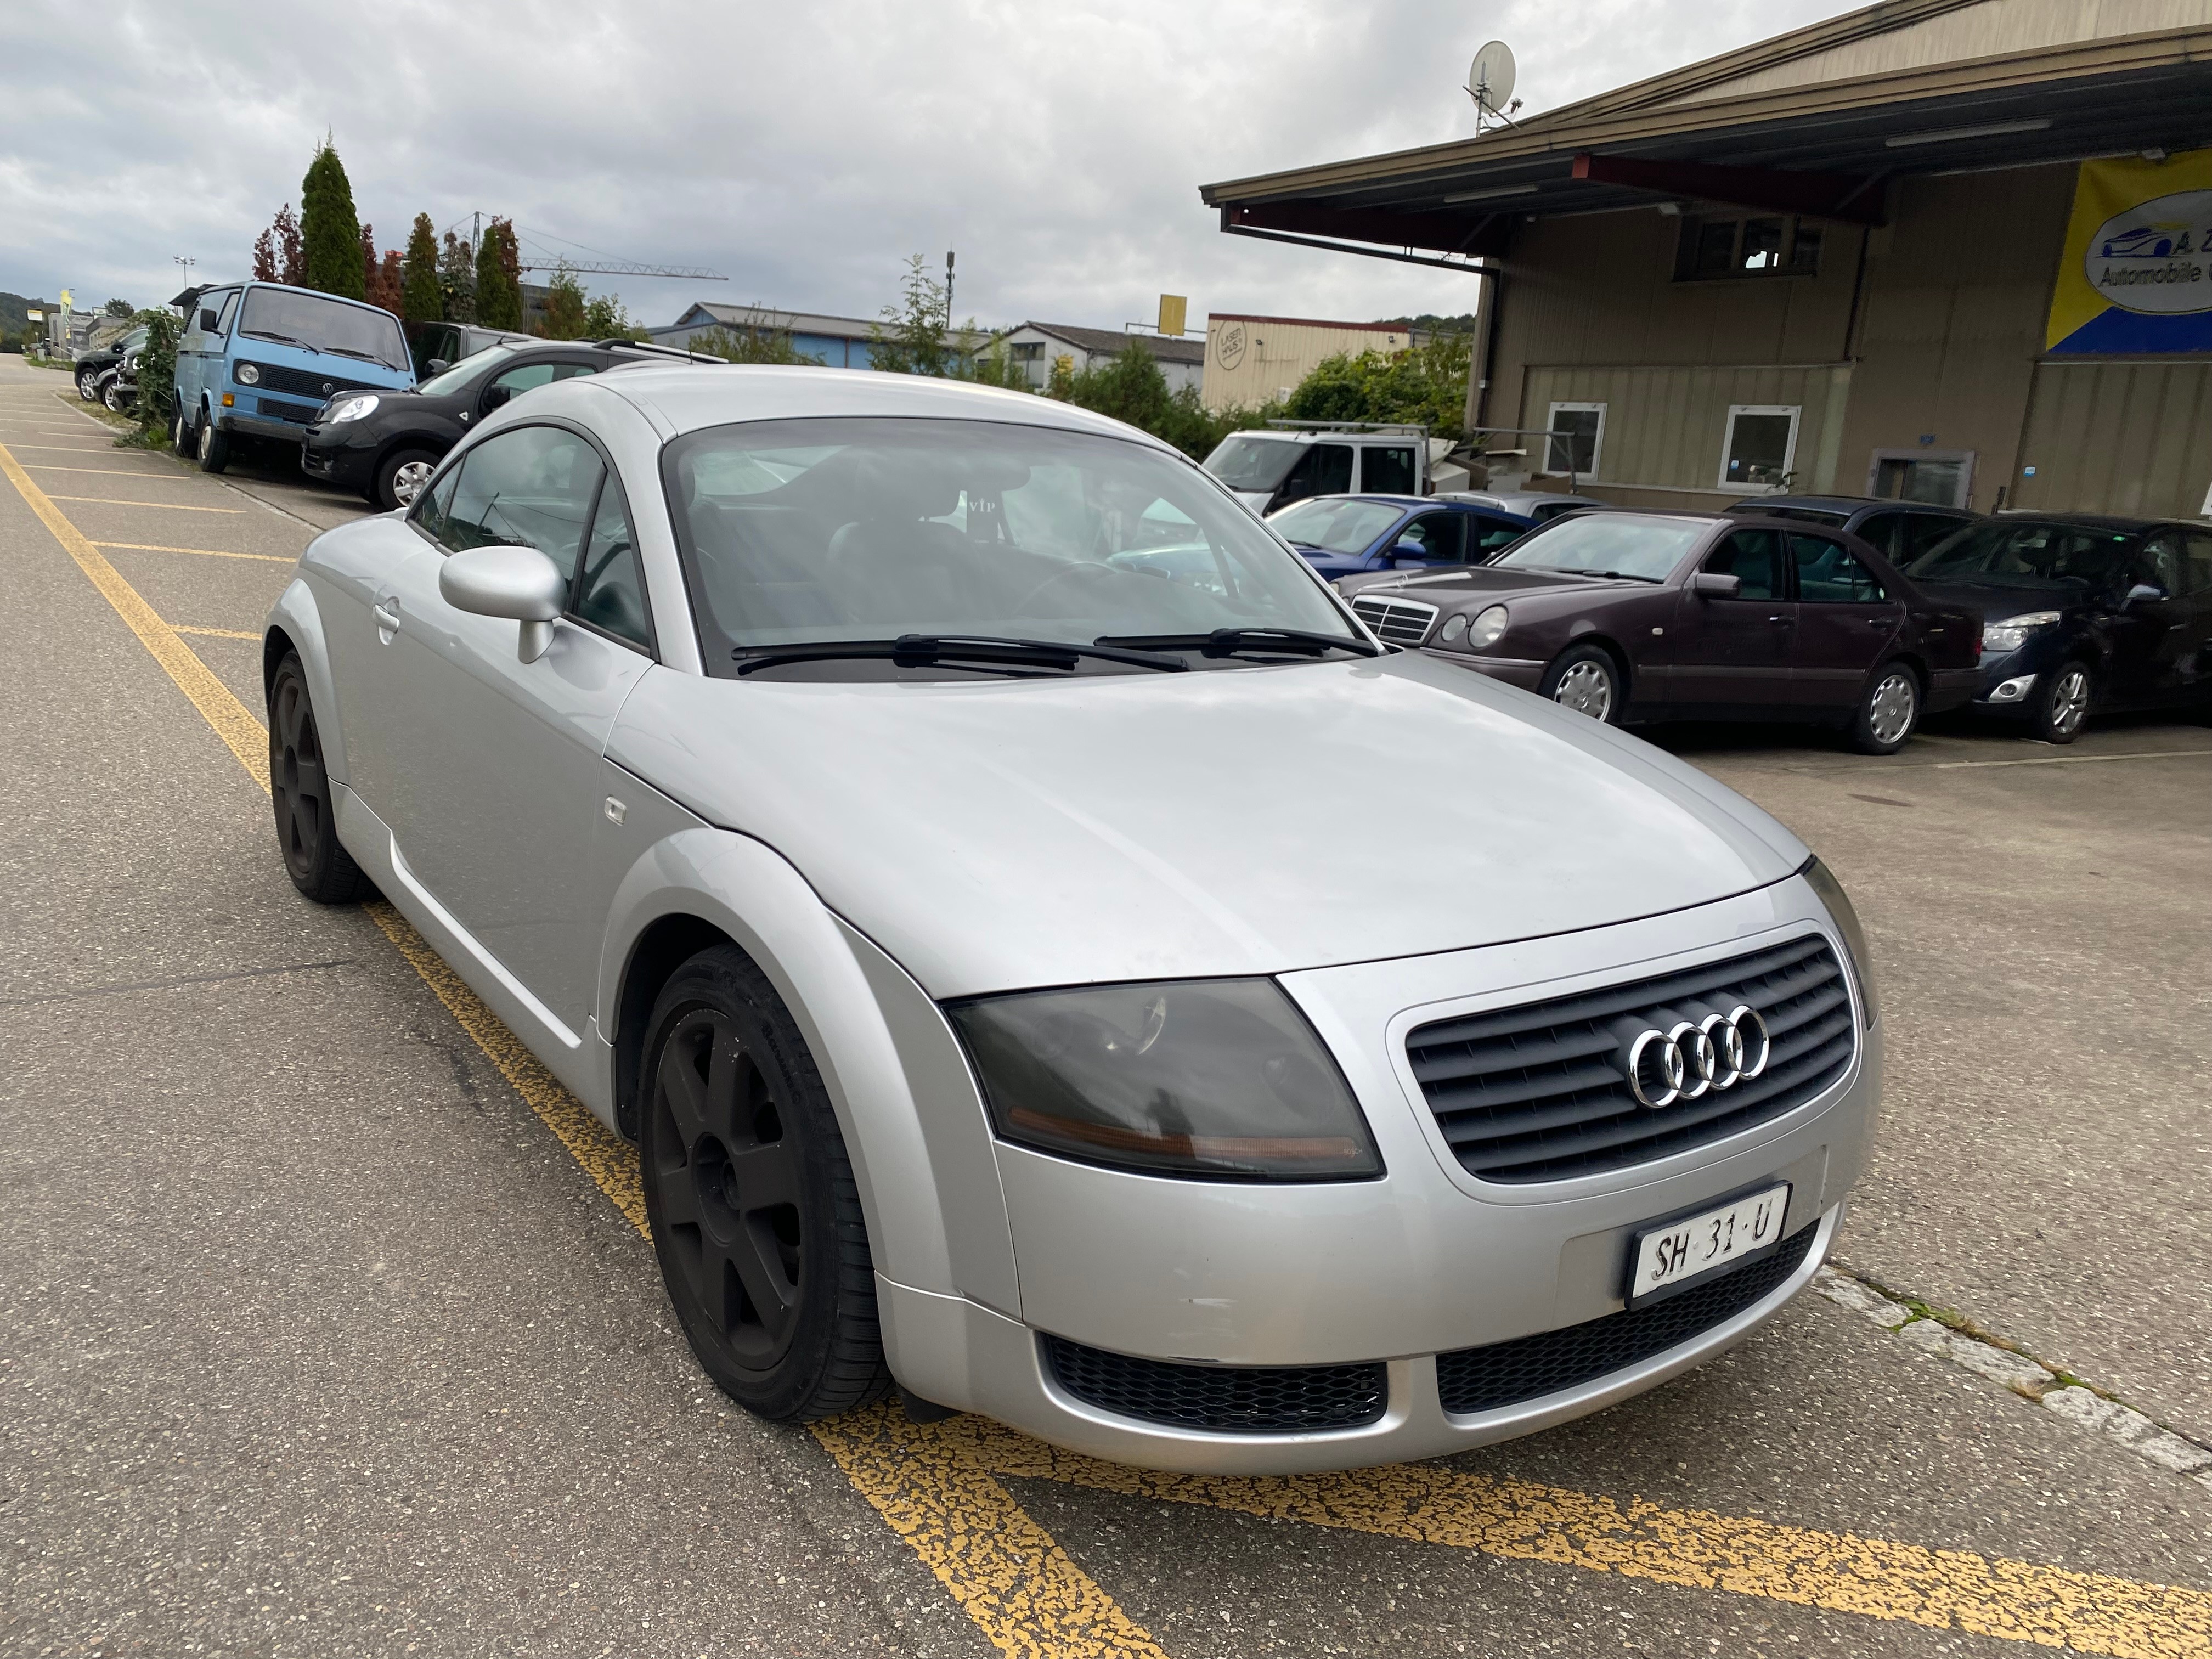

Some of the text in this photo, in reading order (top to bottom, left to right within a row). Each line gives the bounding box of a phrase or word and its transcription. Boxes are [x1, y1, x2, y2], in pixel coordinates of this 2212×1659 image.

[2098, 262, 2201, 287] Automobile
[968, 498, 996, 512] VIP
[1651, 1197, 1773, 1281] SH 31 U
